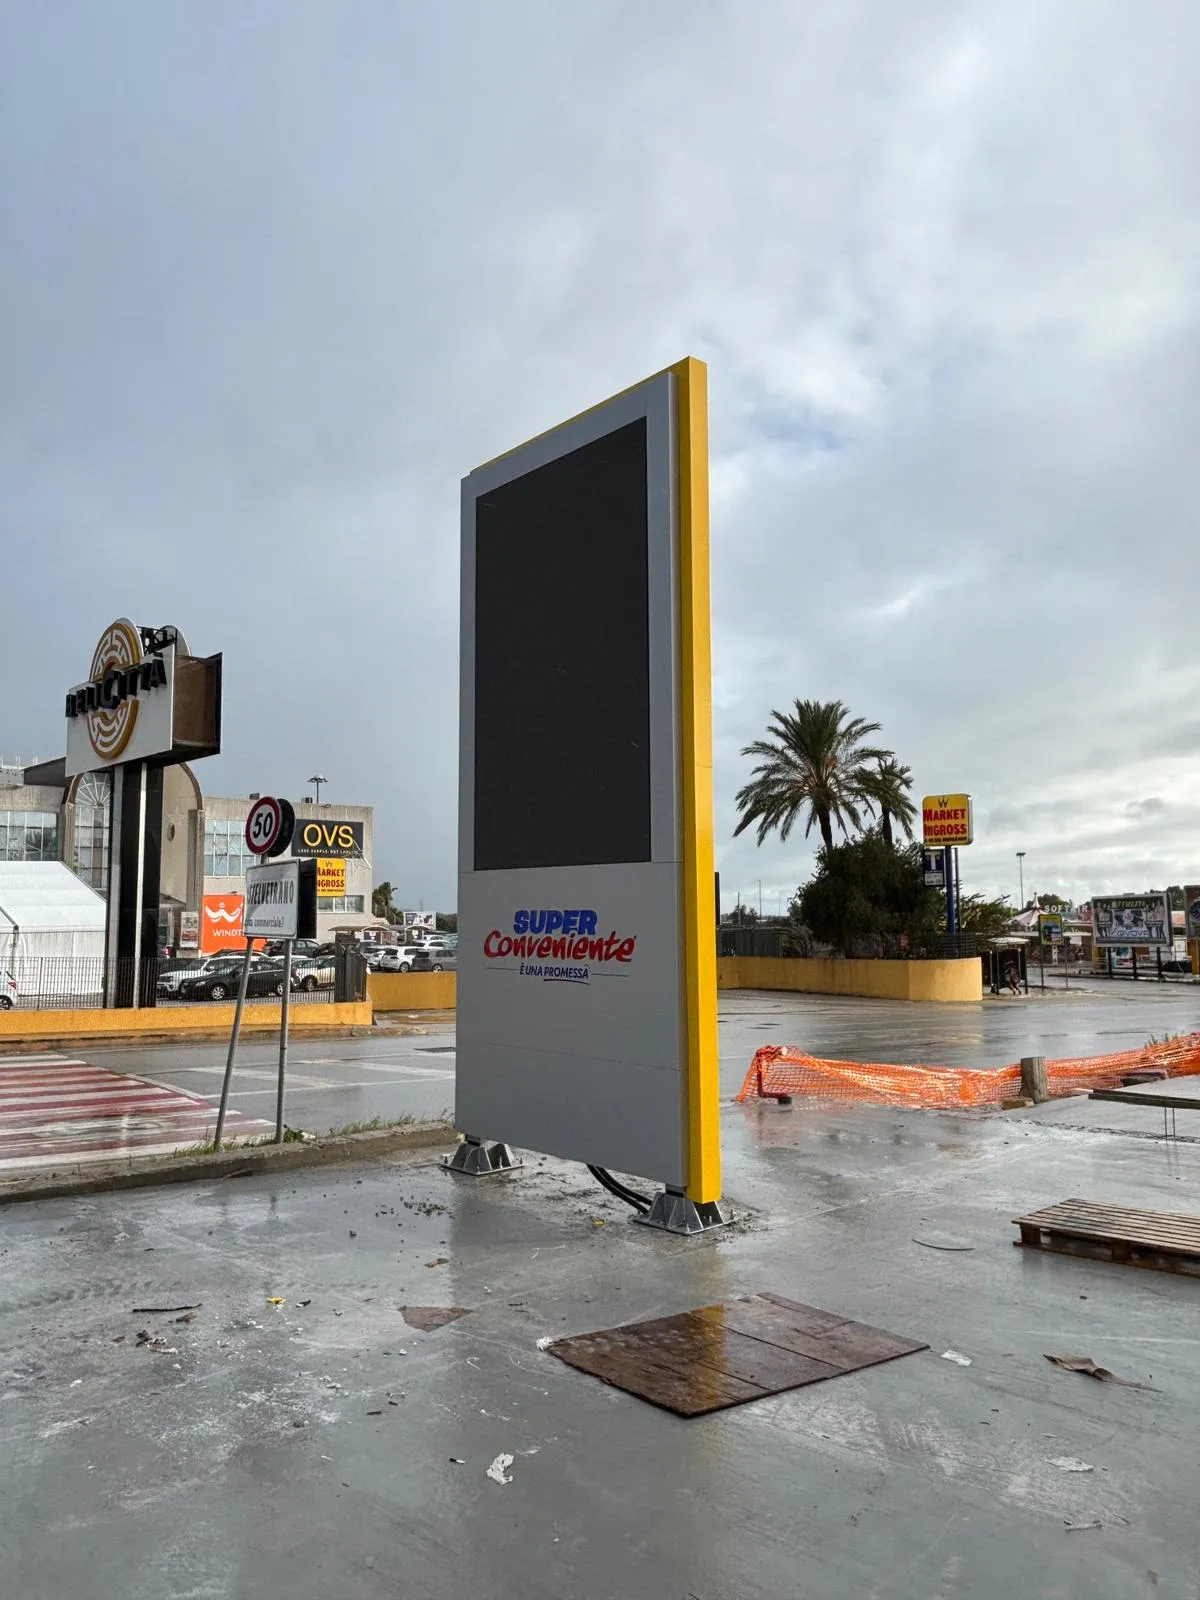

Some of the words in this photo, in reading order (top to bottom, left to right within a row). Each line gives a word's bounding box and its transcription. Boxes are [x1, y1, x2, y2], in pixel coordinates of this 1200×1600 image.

[923, 809, 966, 821] MARKET
[252, 811, 274, 839] 50
[923, 824, 967, 836] INGROSS
[303, 823, 353, 848] OVS
[317, 879, 345, 888] GROSS
[513, 909, 597, 935] SUPER
[213, 929, 243, 937] WINDT
[483, 930, 636, 962] Conveniente
[519, 962, 525, 976] È
[525, 964, 543, 977] UNA
[543, 966, 588, 979] PROMESSA
